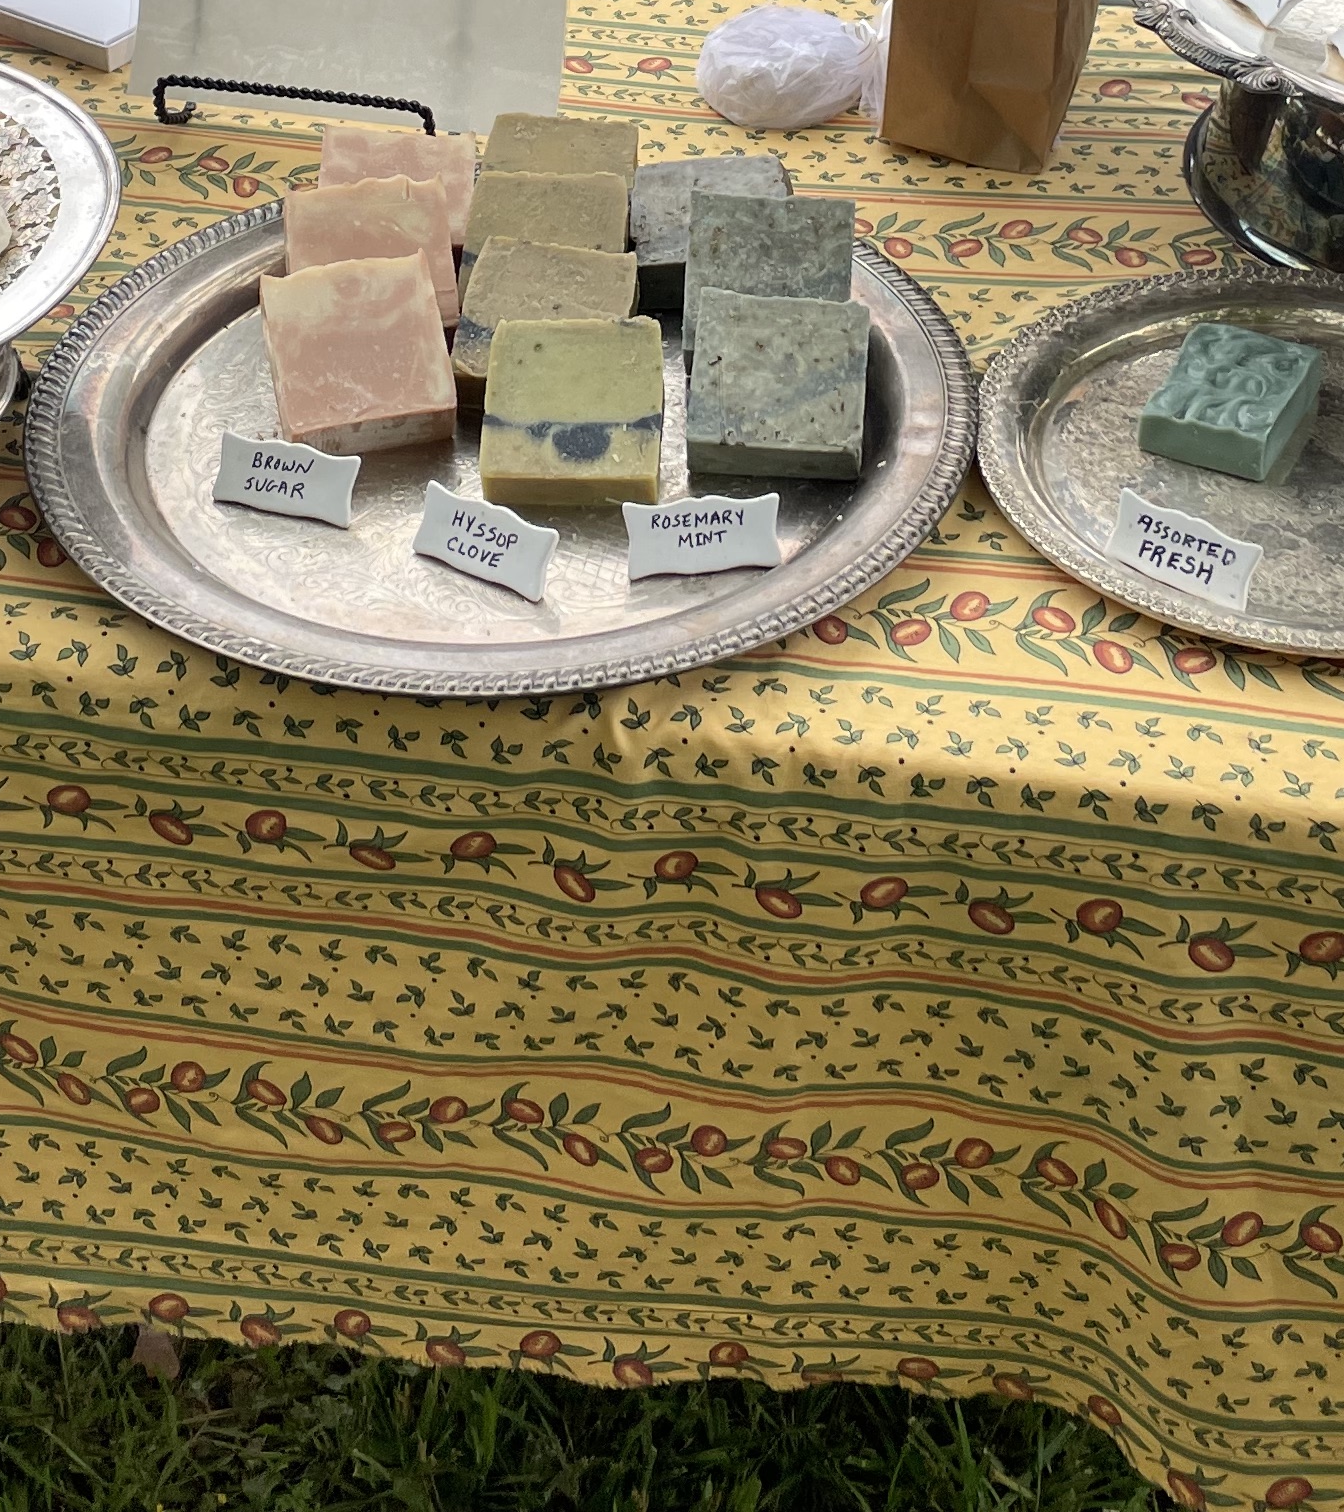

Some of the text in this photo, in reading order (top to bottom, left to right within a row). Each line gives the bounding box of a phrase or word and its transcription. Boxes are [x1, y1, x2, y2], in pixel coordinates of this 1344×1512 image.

[252, 452, 314, 474] BROWN
[244, 476, 305, 499] SUGAR
[451, 510, 518, 549] HYSSOP
[651, 509, 744, 529] ROSEMARY
[446, 537, 504, 568] CLOVE
[678, 530, 727, 548] MINT
[1137, 514, 1236, 566] ASSORTED
[1139, 539, 1213, 585] FRESH
